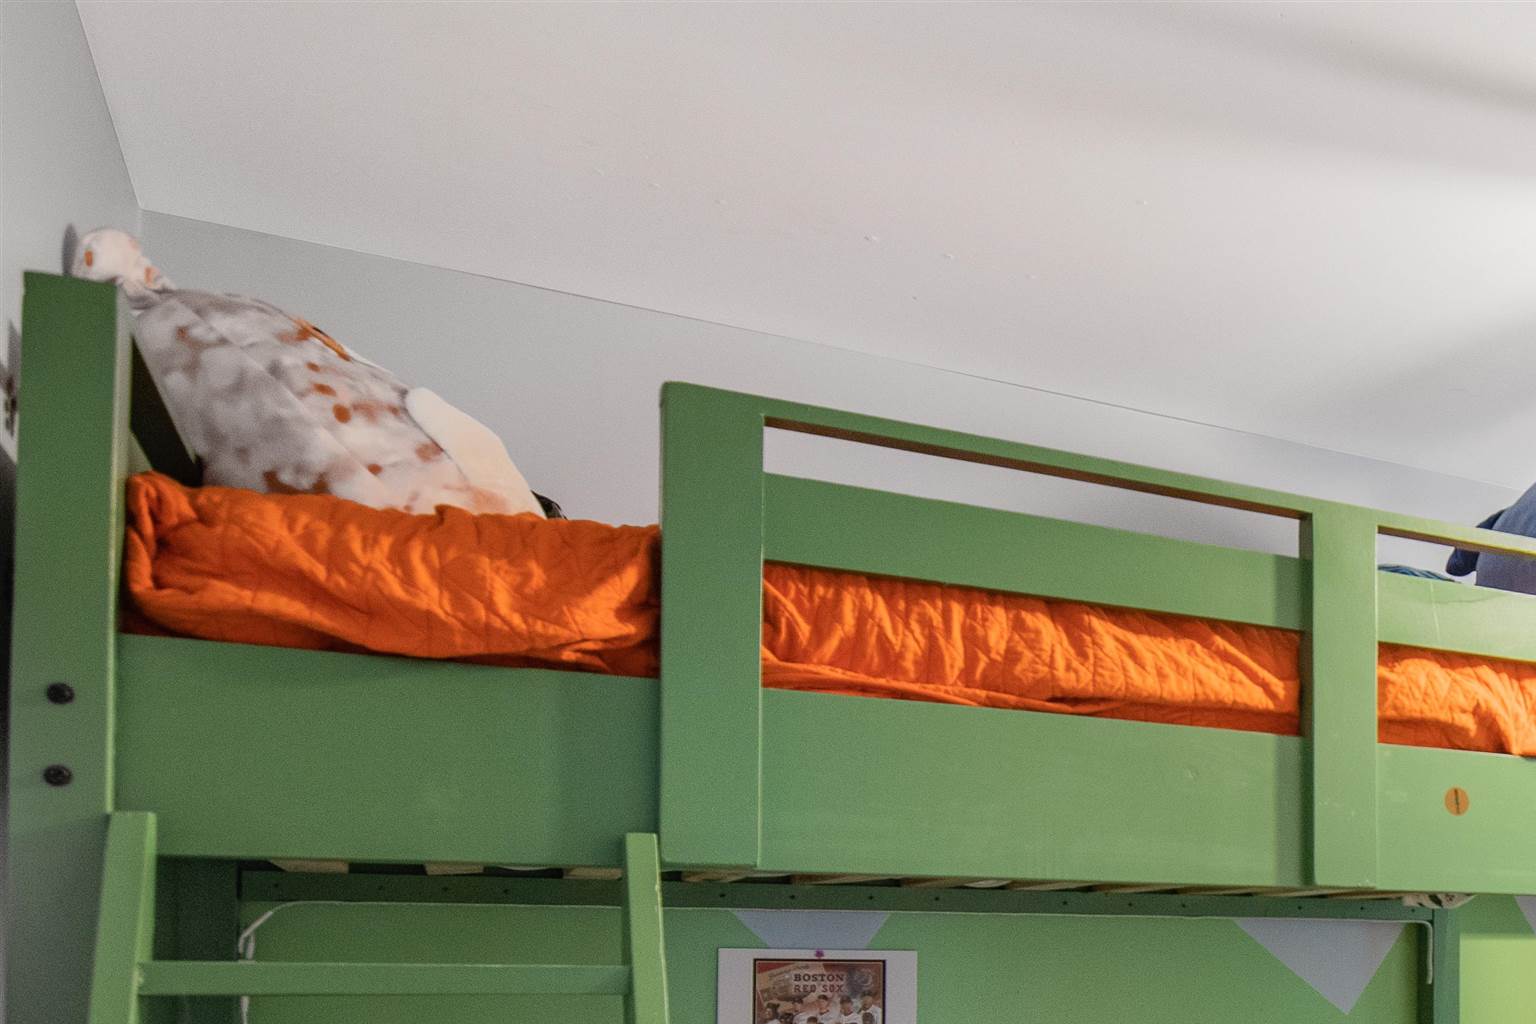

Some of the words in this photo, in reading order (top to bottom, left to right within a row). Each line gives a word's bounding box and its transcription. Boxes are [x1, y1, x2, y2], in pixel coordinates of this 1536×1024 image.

[793, 973, 845, 982] BOSTON
[793, 984, 817, 993] RED
[821, 984, 844, 993] SOX
